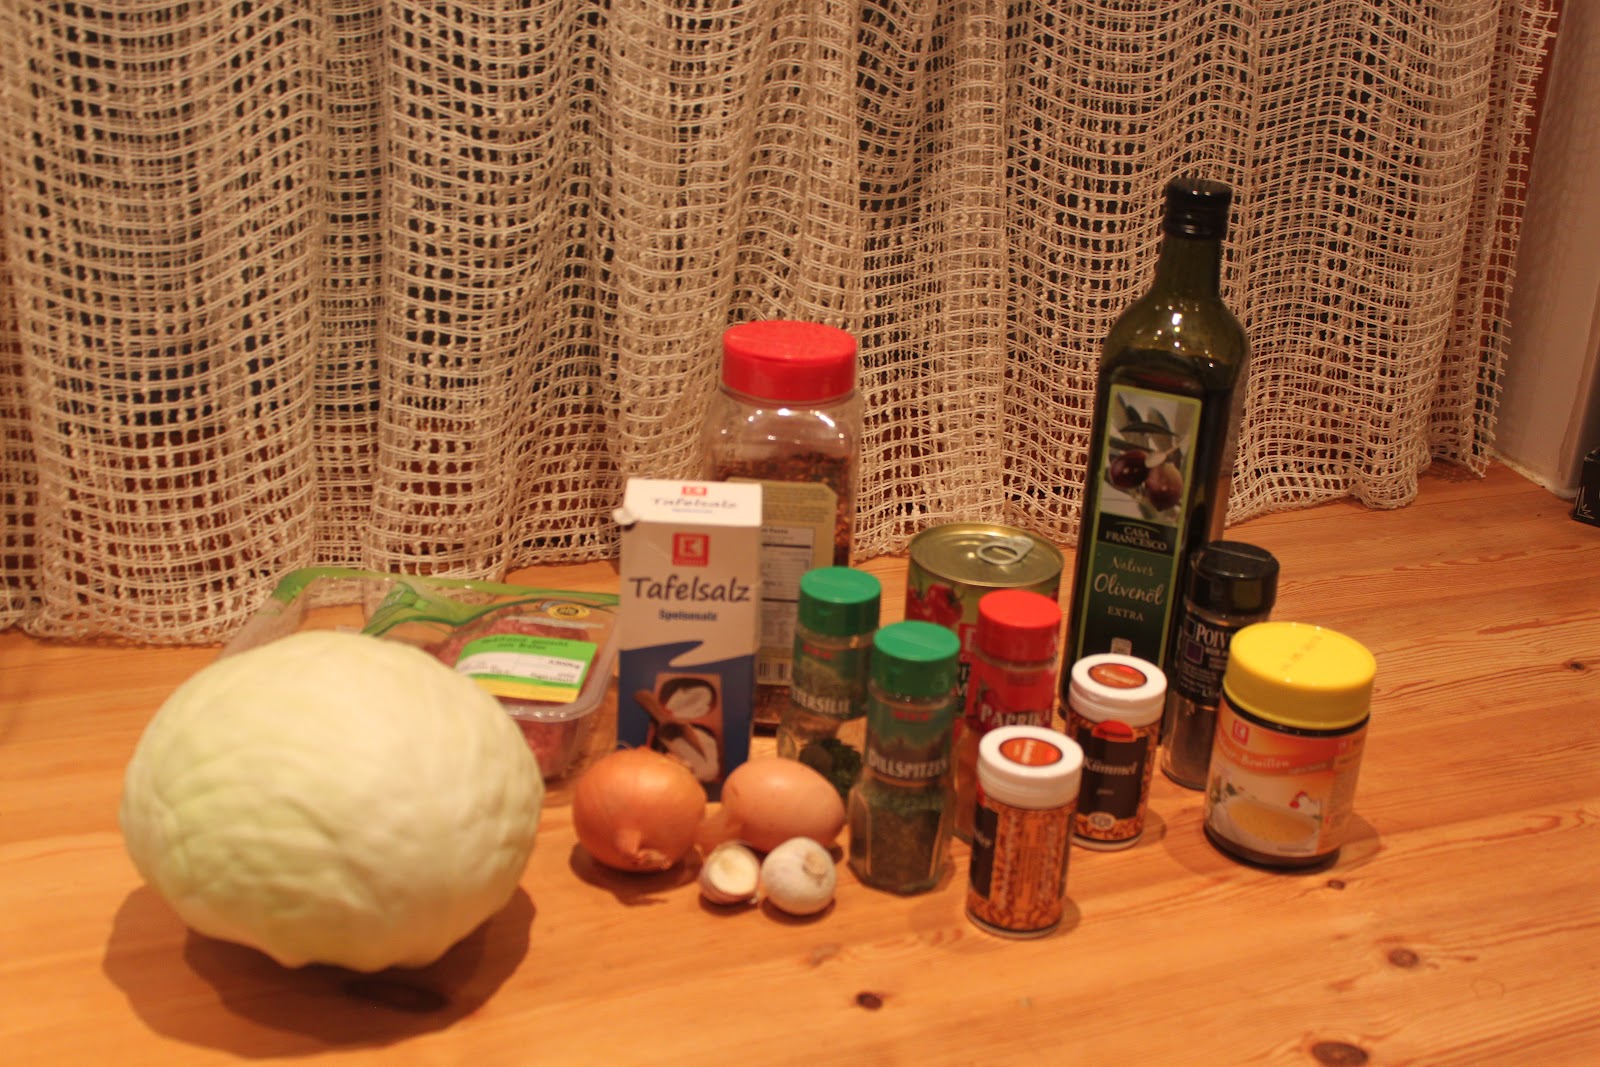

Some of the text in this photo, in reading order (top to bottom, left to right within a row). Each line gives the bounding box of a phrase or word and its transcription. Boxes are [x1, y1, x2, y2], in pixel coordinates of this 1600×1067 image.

[1105, 530, 1168, 552] FRANCESCO
[1122, 525, 1151, 540] CASA
[628, 573, 752, 604] Tafelsalz
[1094, 572, 1165, 606] Olivenöl
[1107, 605, 1145, 622] EXTRA
